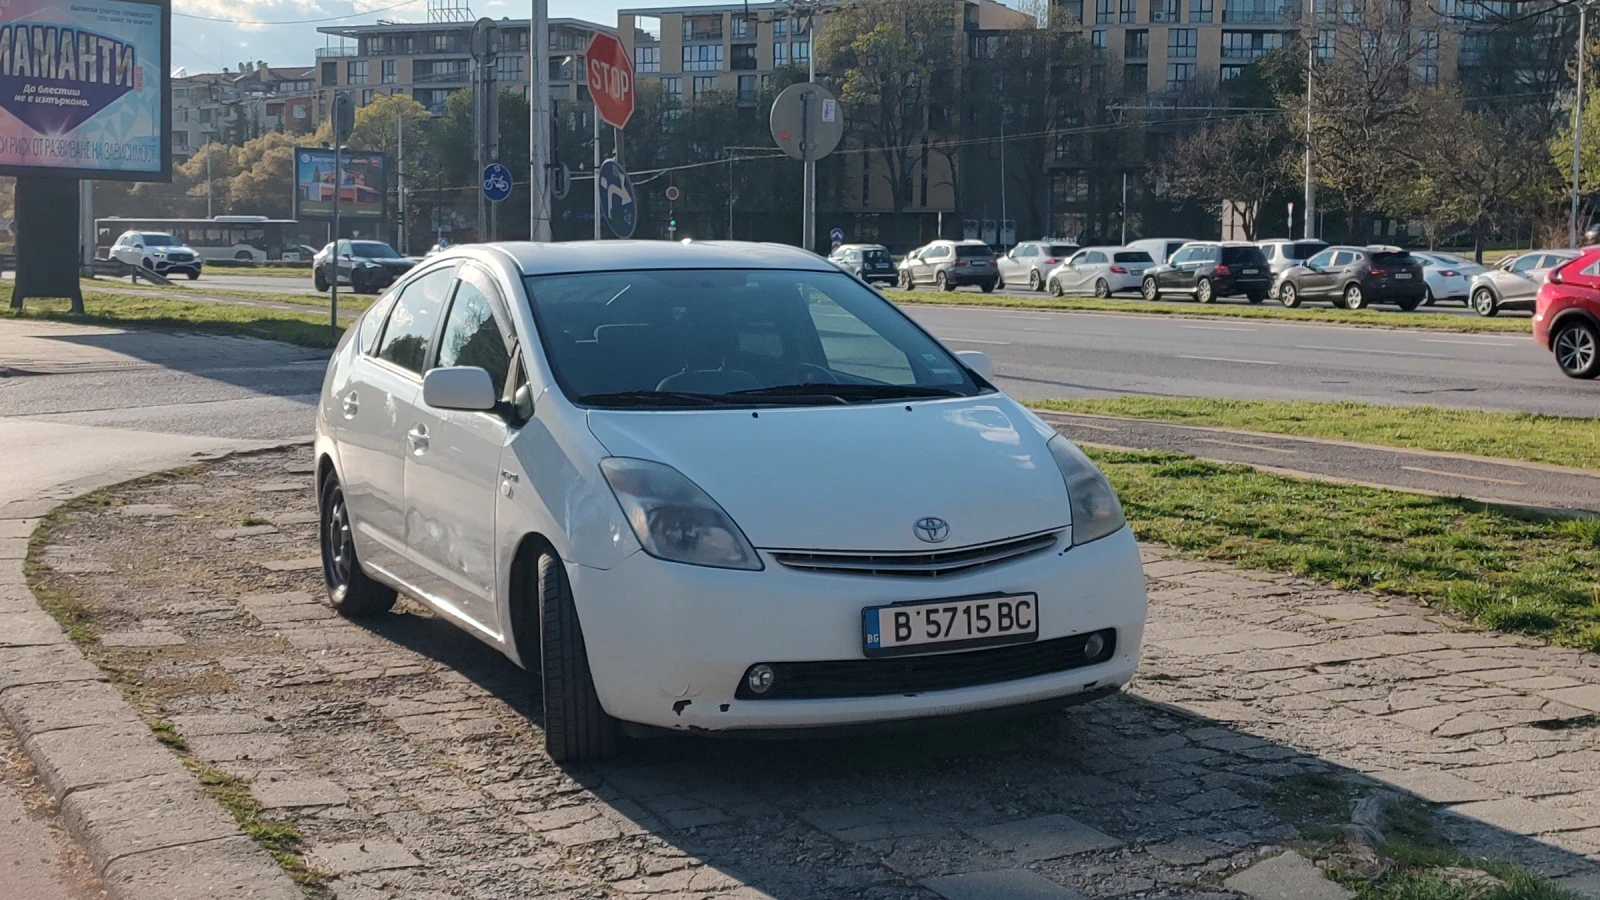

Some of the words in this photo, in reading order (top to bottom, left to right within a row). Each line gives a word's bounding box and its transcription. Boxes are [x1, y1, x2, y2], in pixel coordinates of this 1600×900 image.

[591, 58, 629, 101] STOP
[14, 94, 26, 102] не
[38, 85, 80, 96] блестиш
[10, 136, 31, 156] РИСК
[33, 138, 44, 156] ОТ
[45, 138, 91, 160] РАЗВИВАНЕ
[894, 611, 912, 642] B
[925, 604, 992, 639] 5715
[997, 600, 1032, 632] BC
[867, 633, 879, 644] BG
